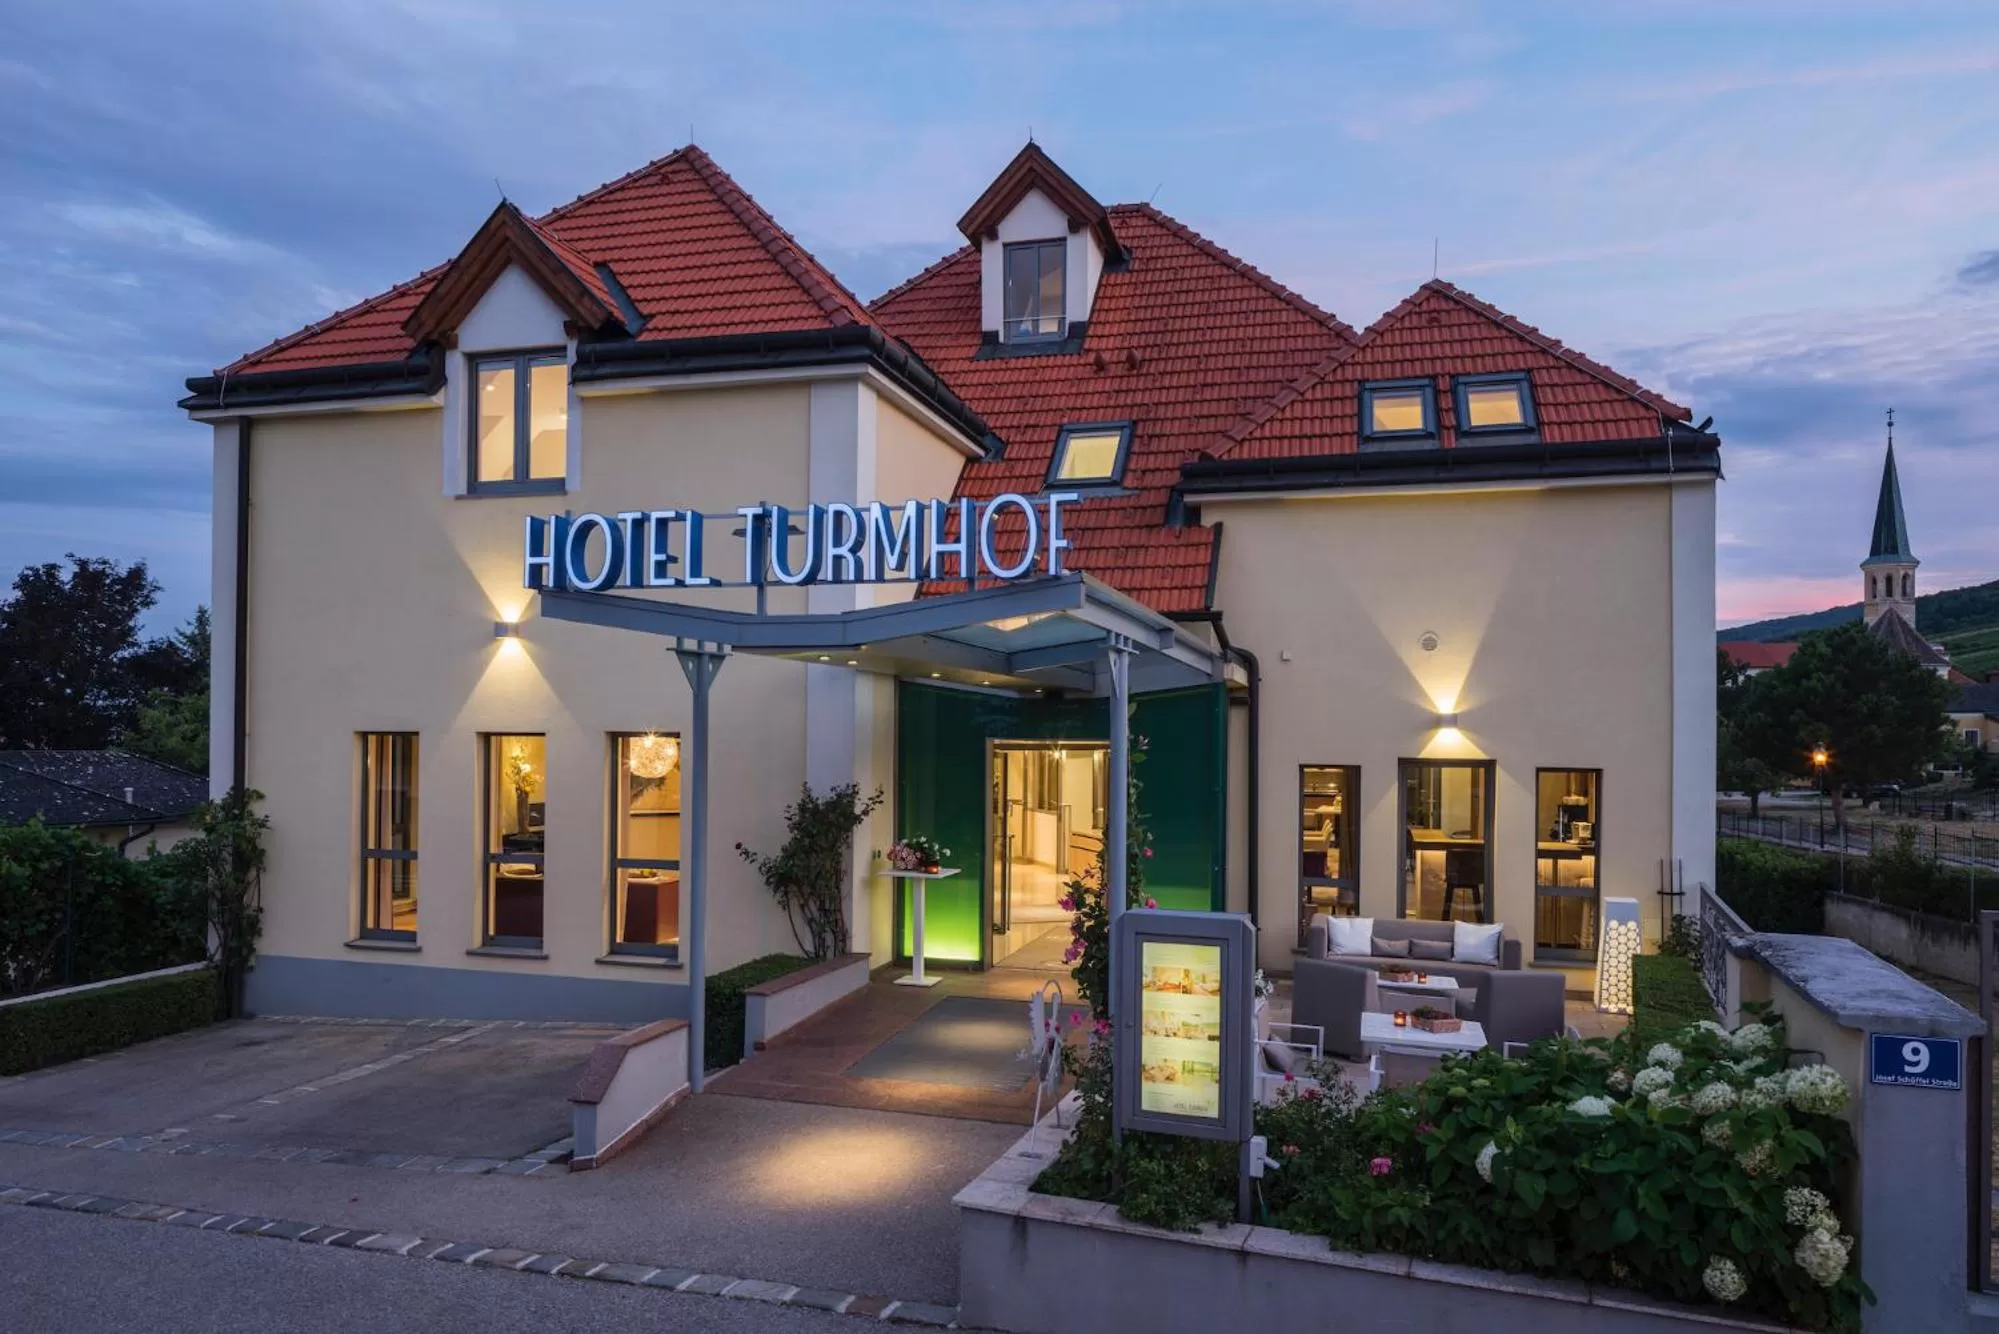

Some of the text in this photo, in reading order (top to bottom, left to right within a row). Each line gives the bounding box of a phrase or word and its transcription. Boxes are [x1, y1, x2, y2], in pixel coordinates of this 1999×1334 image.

[524, 493, 1080, 591] HOTEL TURMHOF
[1902, 1041, 1930, 1073] 9
